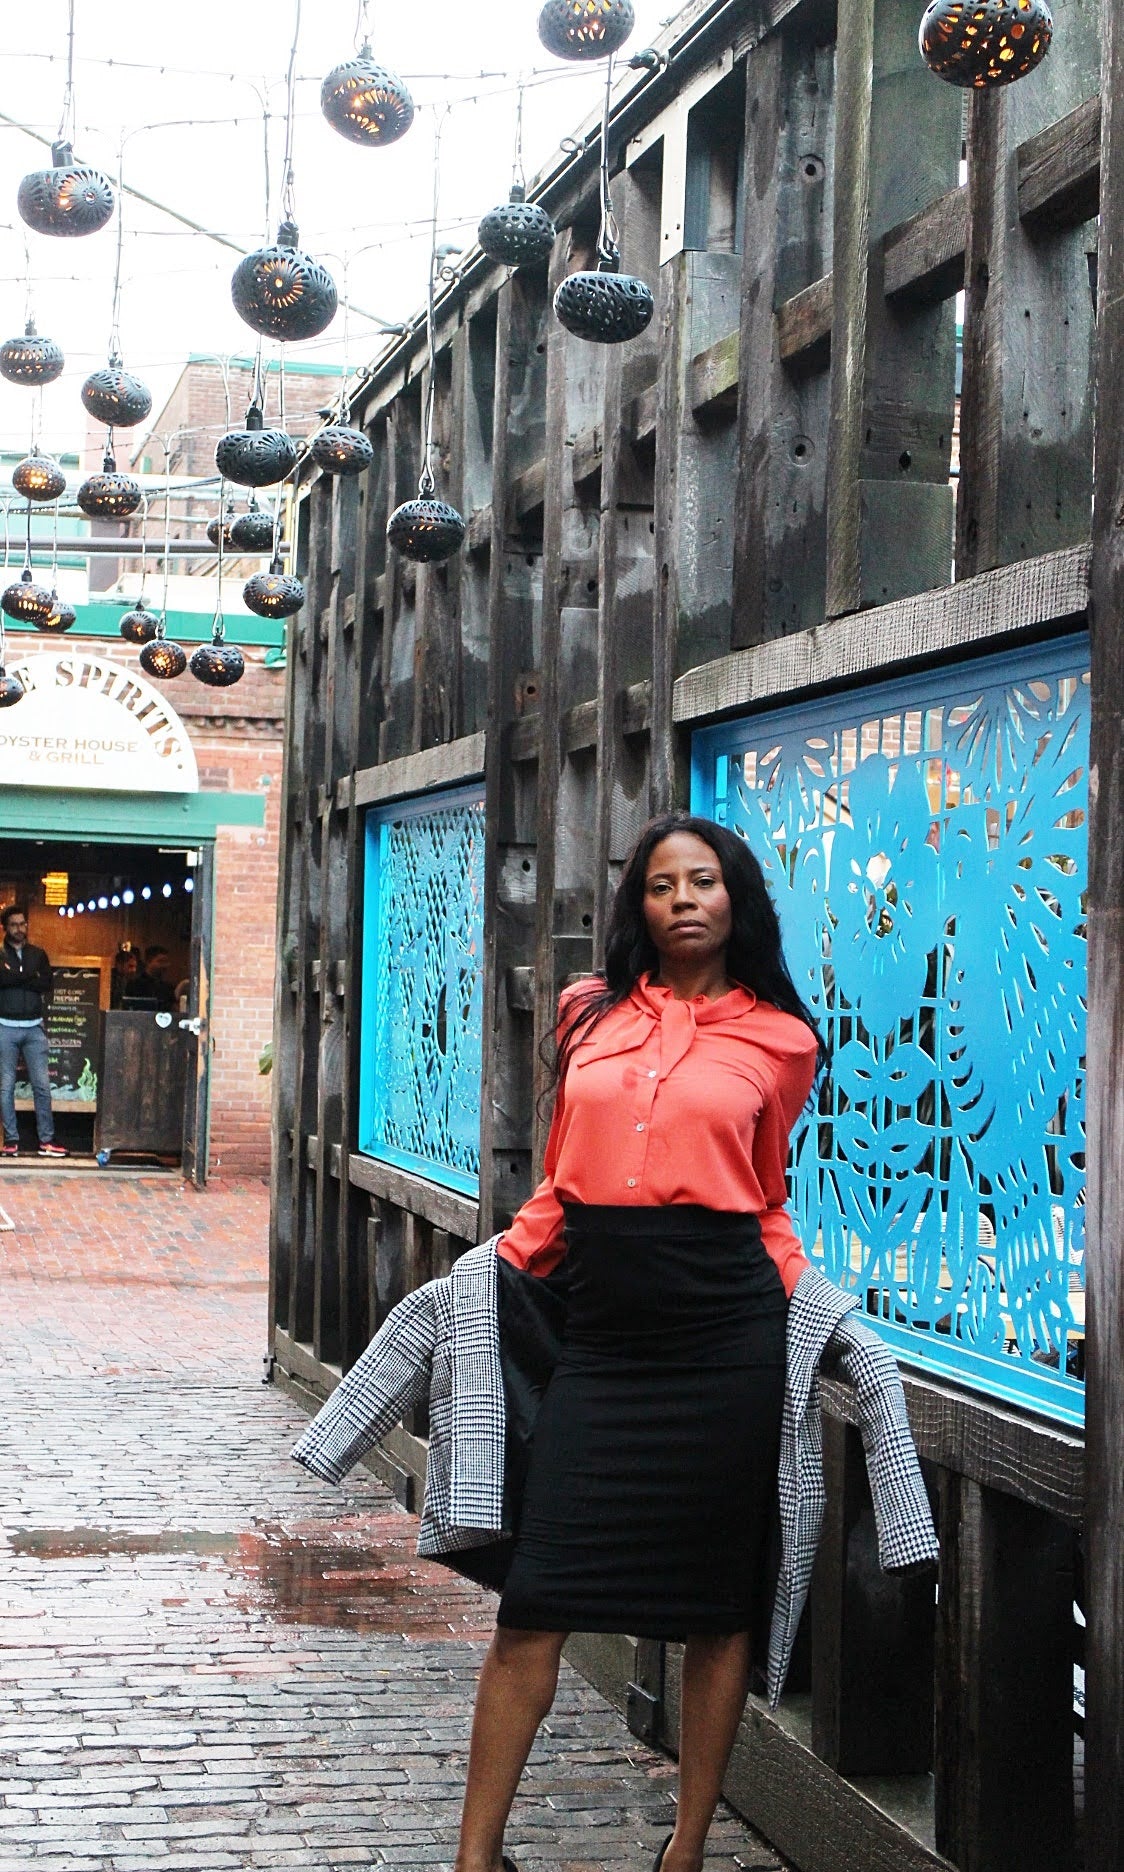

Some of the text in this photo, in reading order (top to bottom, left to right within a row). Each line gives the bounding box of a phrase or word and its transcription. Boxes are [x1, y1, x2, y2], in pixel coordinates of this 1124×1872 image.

[55, 660, 182, 758] SPIRITS
[0, 735, 139, 752] OYSTER HOUSE
[28, 750, 105, 765] & GRILL
